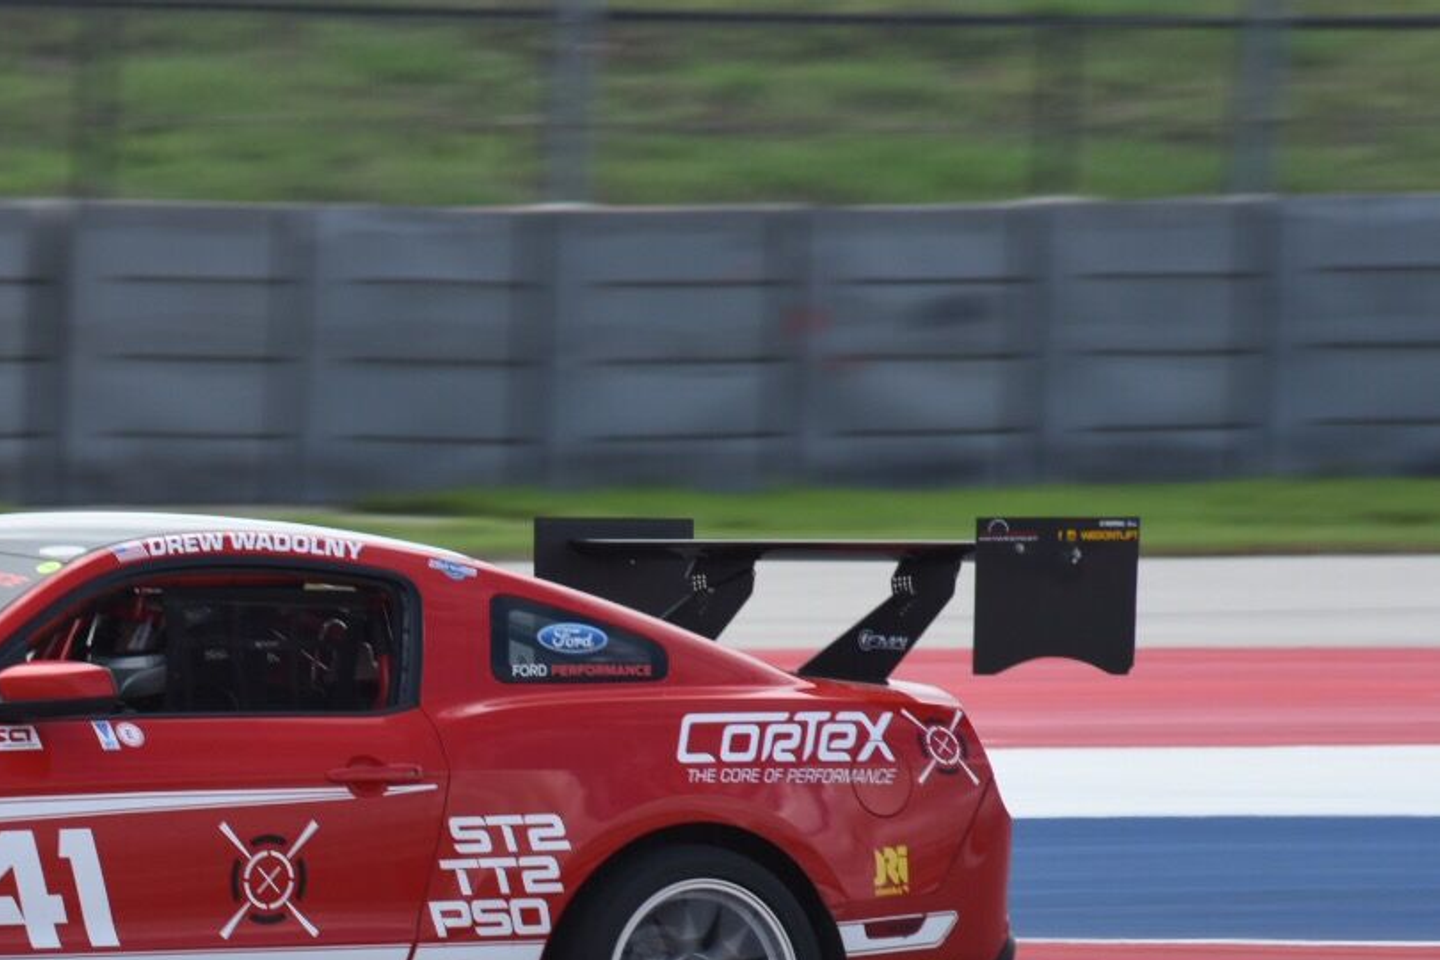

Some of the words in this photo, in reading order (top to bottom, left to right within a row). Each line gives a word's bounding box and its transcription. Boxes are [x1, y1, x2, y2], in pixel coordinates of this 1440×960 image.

[147, 533, 227, 556] DREW
[227, 533, 365, 559] WADOLNY
[550, 626, 596, 649] Ford
[511, 663, 548, 678] FORD
[550, 663, 652, 678] PERFORMANCE
[686, 767, 717, 783] THE
[719, 767, 761, 783] CORE
[763, 767, 785, 783] OF
[785, 767, 899, 785] PERFORMANCE
[448, 812, 573, 855] ST2
[438, 855, 565, 896] TT2
